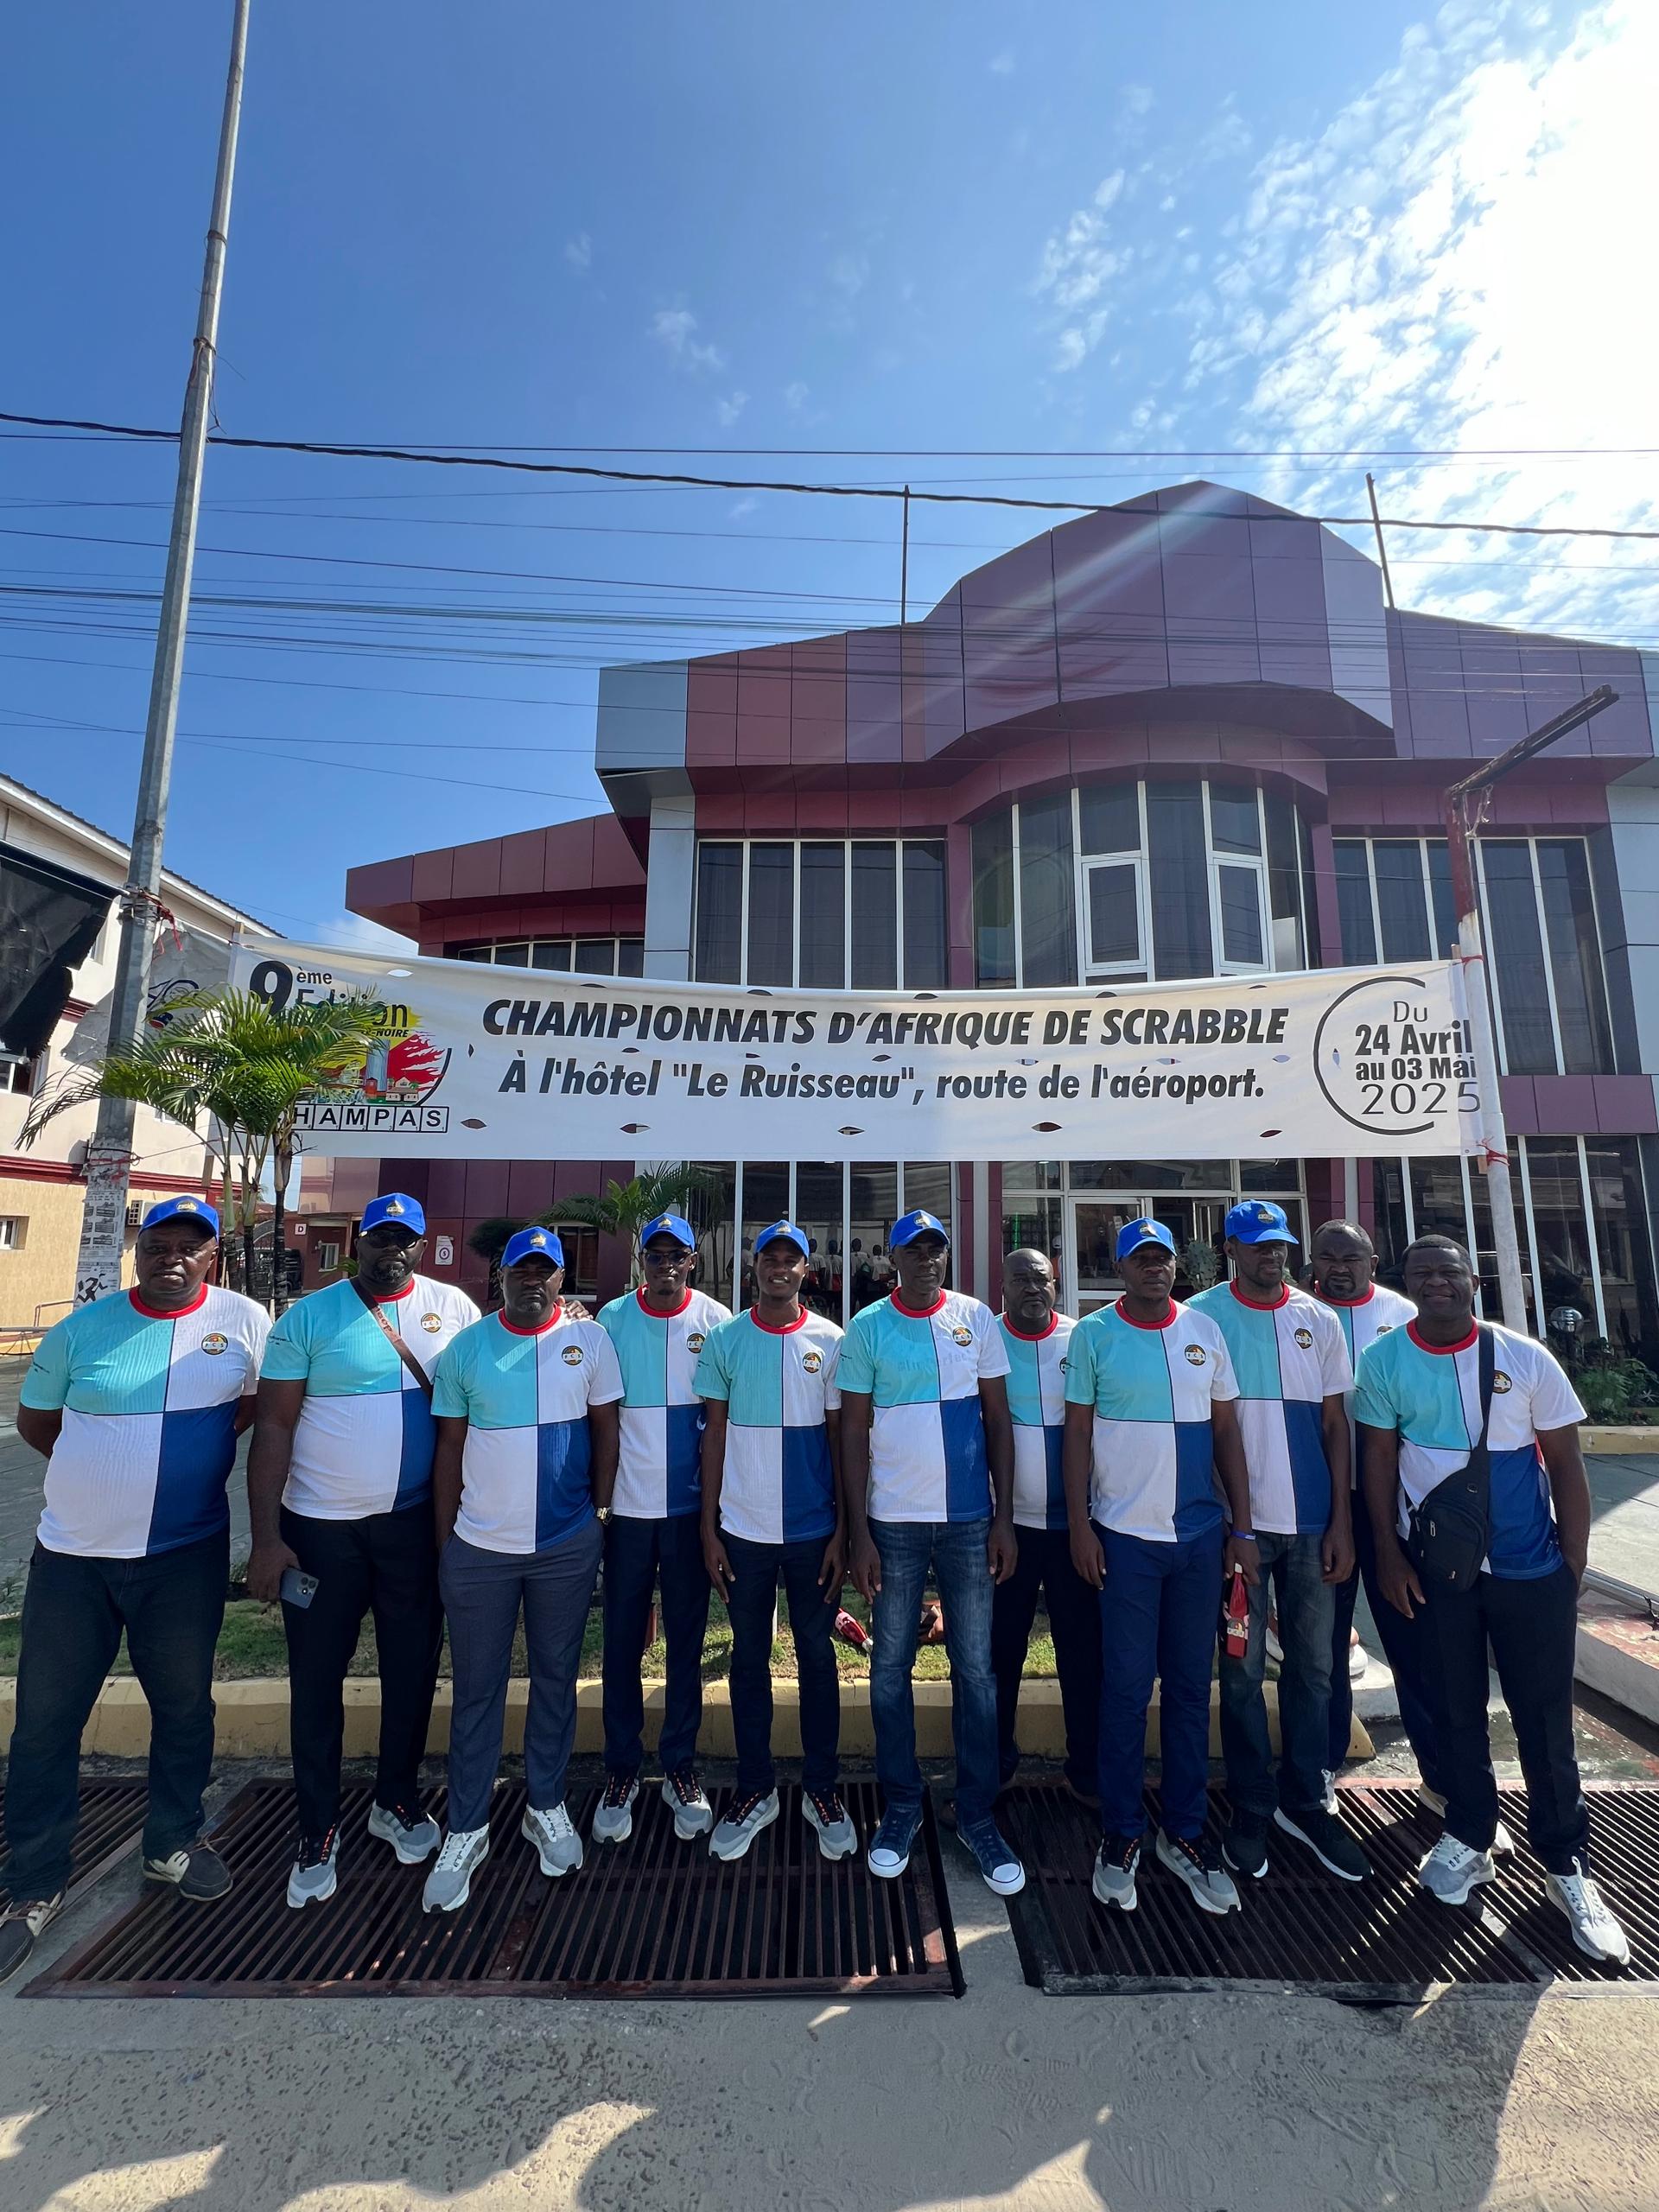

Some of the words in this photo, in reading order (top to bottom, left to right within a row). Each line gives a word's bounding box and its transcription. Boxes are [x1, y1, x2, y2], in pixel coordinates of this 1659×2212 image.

[482, 999, 817, 1045] CHAMPIONNATS
[827, 1011, 1035, 1049] D'AFRIQUE
[1042, 1009, 1092, 1045] DE
[1100, 1007, 1289, 1046] SCRABBLE
[1393, 1001, 1428, 1022] Du
[1355, 1024, 1390, 1056] 24
[1400, 1019, 1473, 1054] Avril
[498, 1049, 526, 1093] À
[538, 1057, 662, 1096] l'hôtel
[936, 1070, 1027, 1099] route
[1039, 1064, 1080, 1099] de
[1090, 1064, 1264, 1105] l'aéroport.
[1355, 1062, 1385, 1081] au
[1391, 1058, 1422, 1081] 03
[1429, 1056, 1477, 1079] Mai
[1361, 1081, 1481, 1115] 2025
[278, 1107, 442, 1128] HAMPAS
